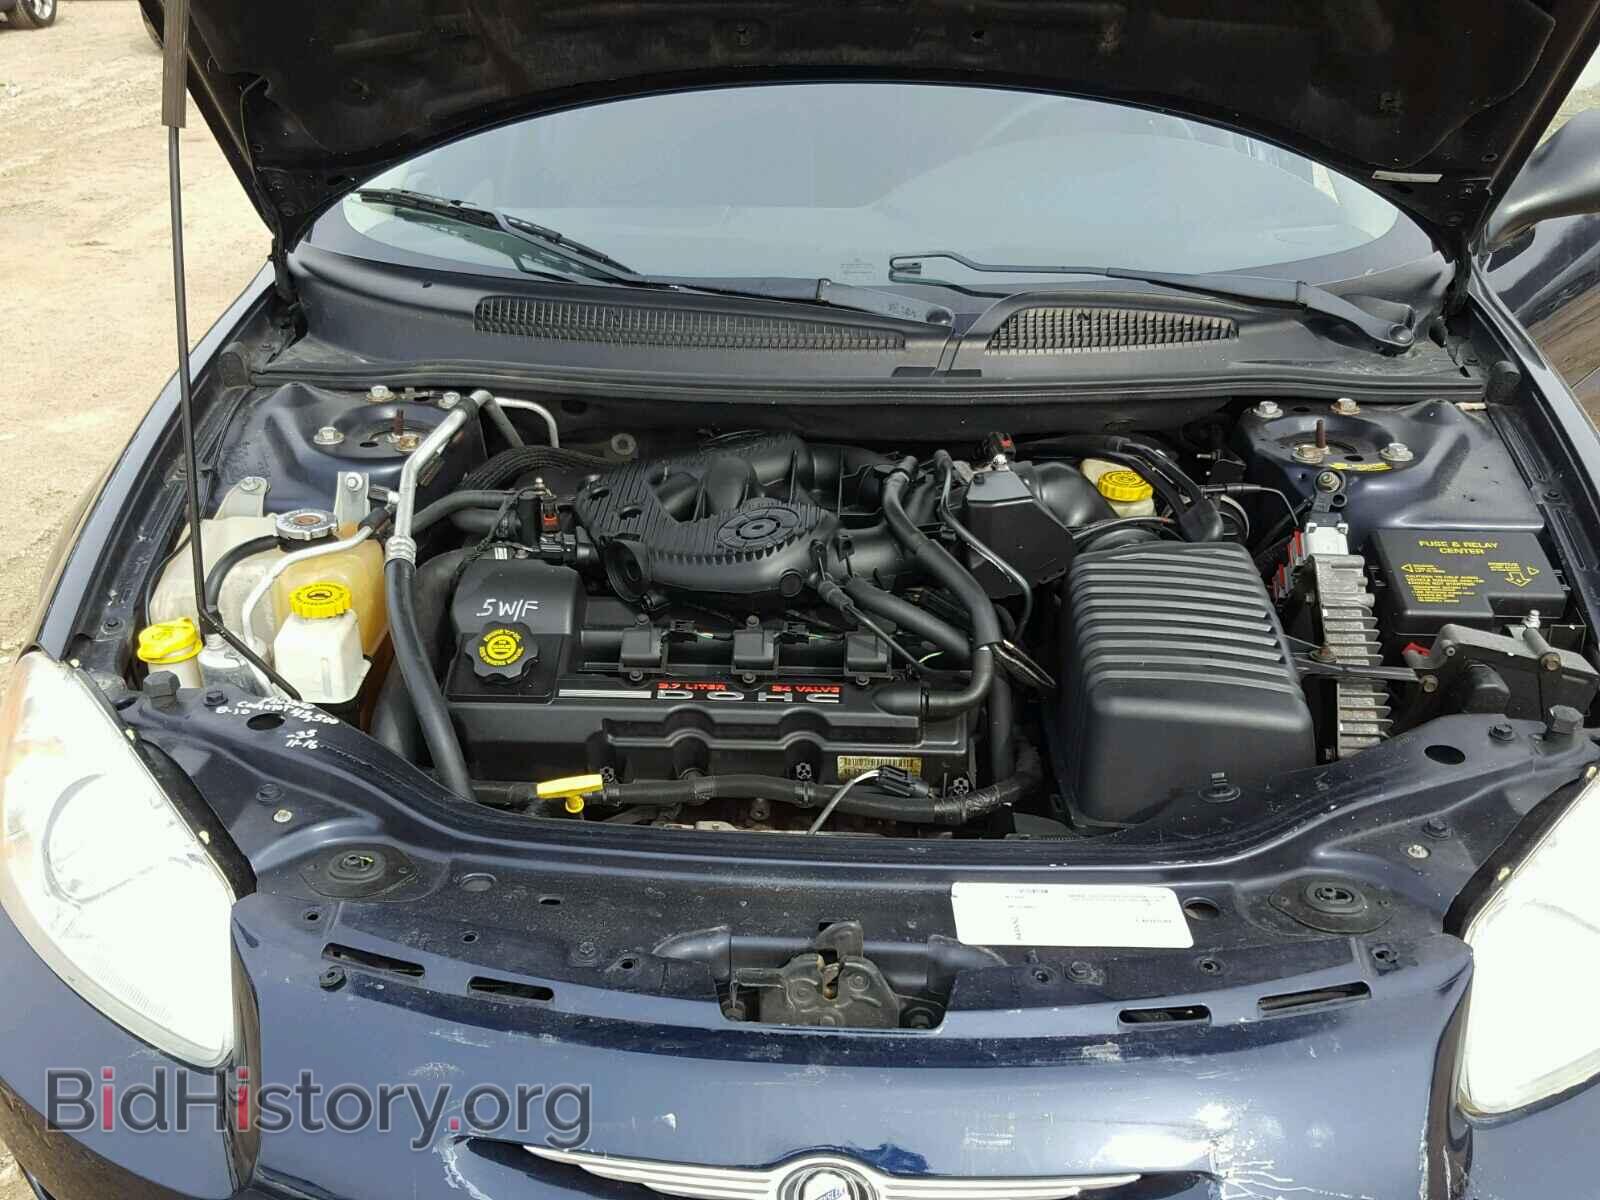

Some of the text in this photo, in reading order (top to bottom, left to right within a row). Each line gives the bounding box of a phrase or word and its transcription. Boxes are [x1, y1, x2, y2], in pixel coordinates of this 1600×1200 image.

[1463, 541, 1499, 549] RELAY
[1439, 547, 1485, 555] CENTER
[685, 682, 727, 691] LITER
[795, 686, 841, 694] VALVE
[656, 690, 841, 704] DOHC
